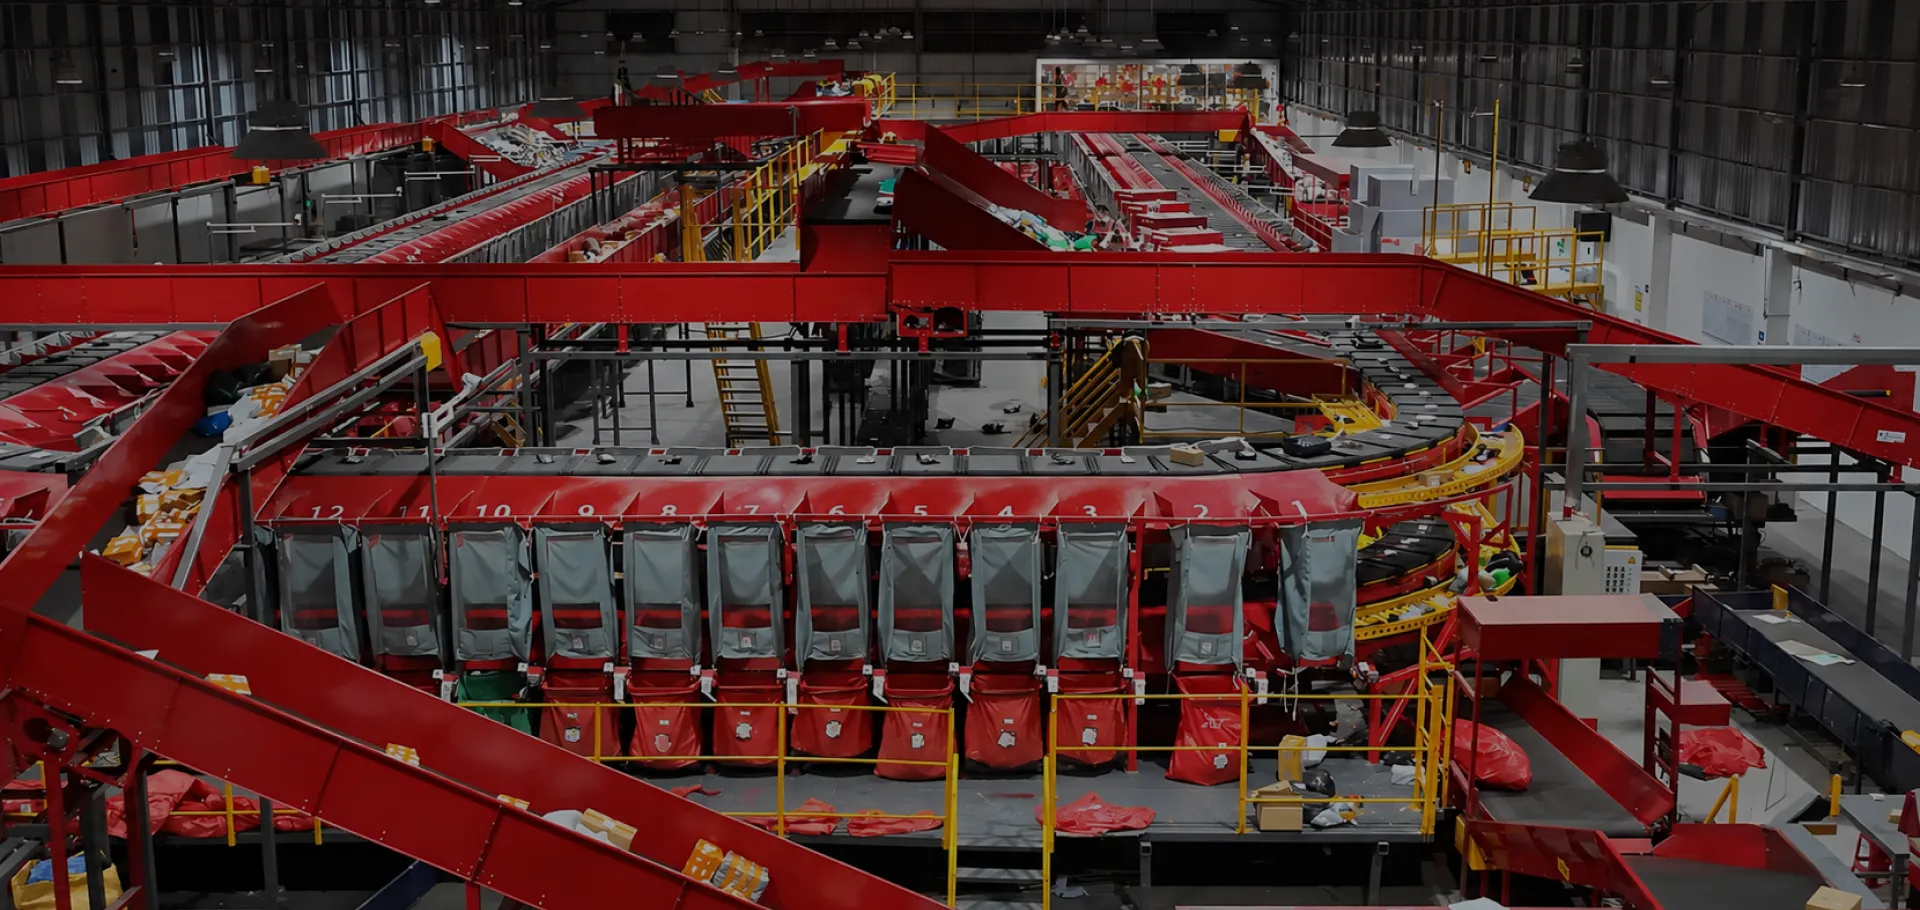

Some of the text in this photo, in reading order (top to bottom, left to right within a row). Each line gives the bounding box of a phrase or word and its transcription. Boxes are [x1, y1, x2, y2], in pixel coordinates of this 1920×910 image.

[311, 505, 345, 519] 12
[399, 505, 430, 518] 11
[476, 504, 512, 517] 10
[577, 504, 596, 516] 9
[660, 504, 678, 516] 8
[743, 504, 760, 515] 7
[828, 504, 845, 516] 6
[912, 505, 929, 516] 5
[997, 504, 1015, 517] 4
[1082, 504, 1098, 517] 3
[1192, 504, 1210, 518] 2
[1291, 499, 1308, 516] 1
